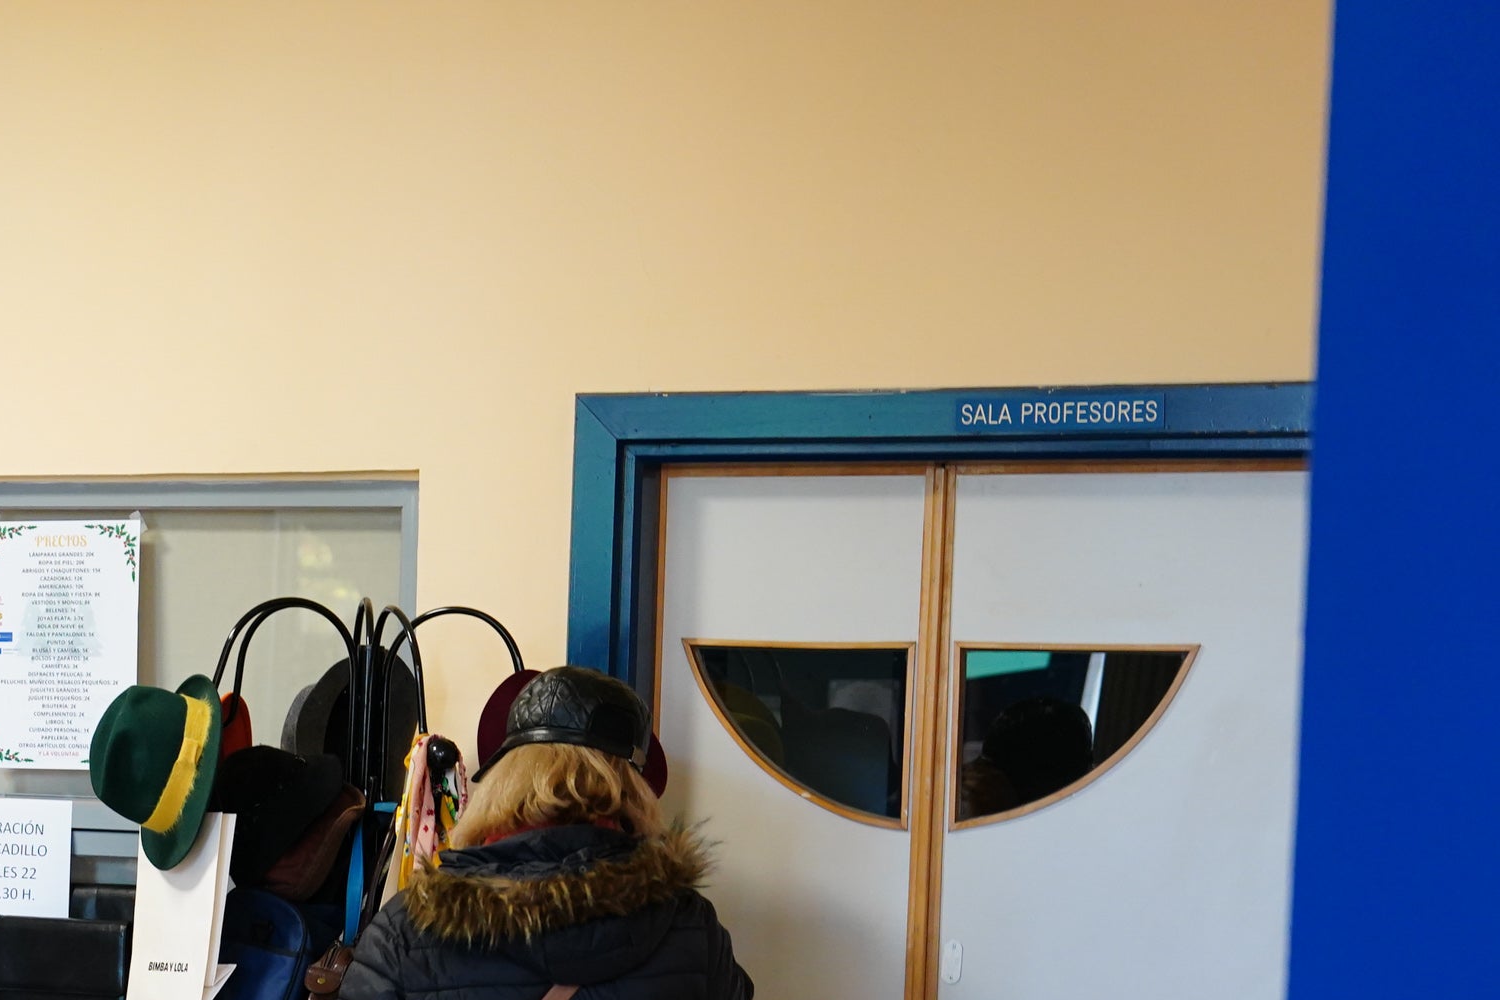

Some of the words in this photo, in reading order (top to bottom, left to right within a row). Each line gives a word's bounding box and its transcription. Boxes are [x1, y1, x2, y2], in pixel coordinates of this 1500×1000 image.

[961, 403, 1012, 425] SALA
[1021, 400, 1158, 424] PROFESORES
[21, 867, 37, 880] 22
[22, 889, 35, 901] H.
[148, 962, 168, 971] BIMBA
[169, 963, 174, 971] Y
[174, 963, 189, 972] LOLA
